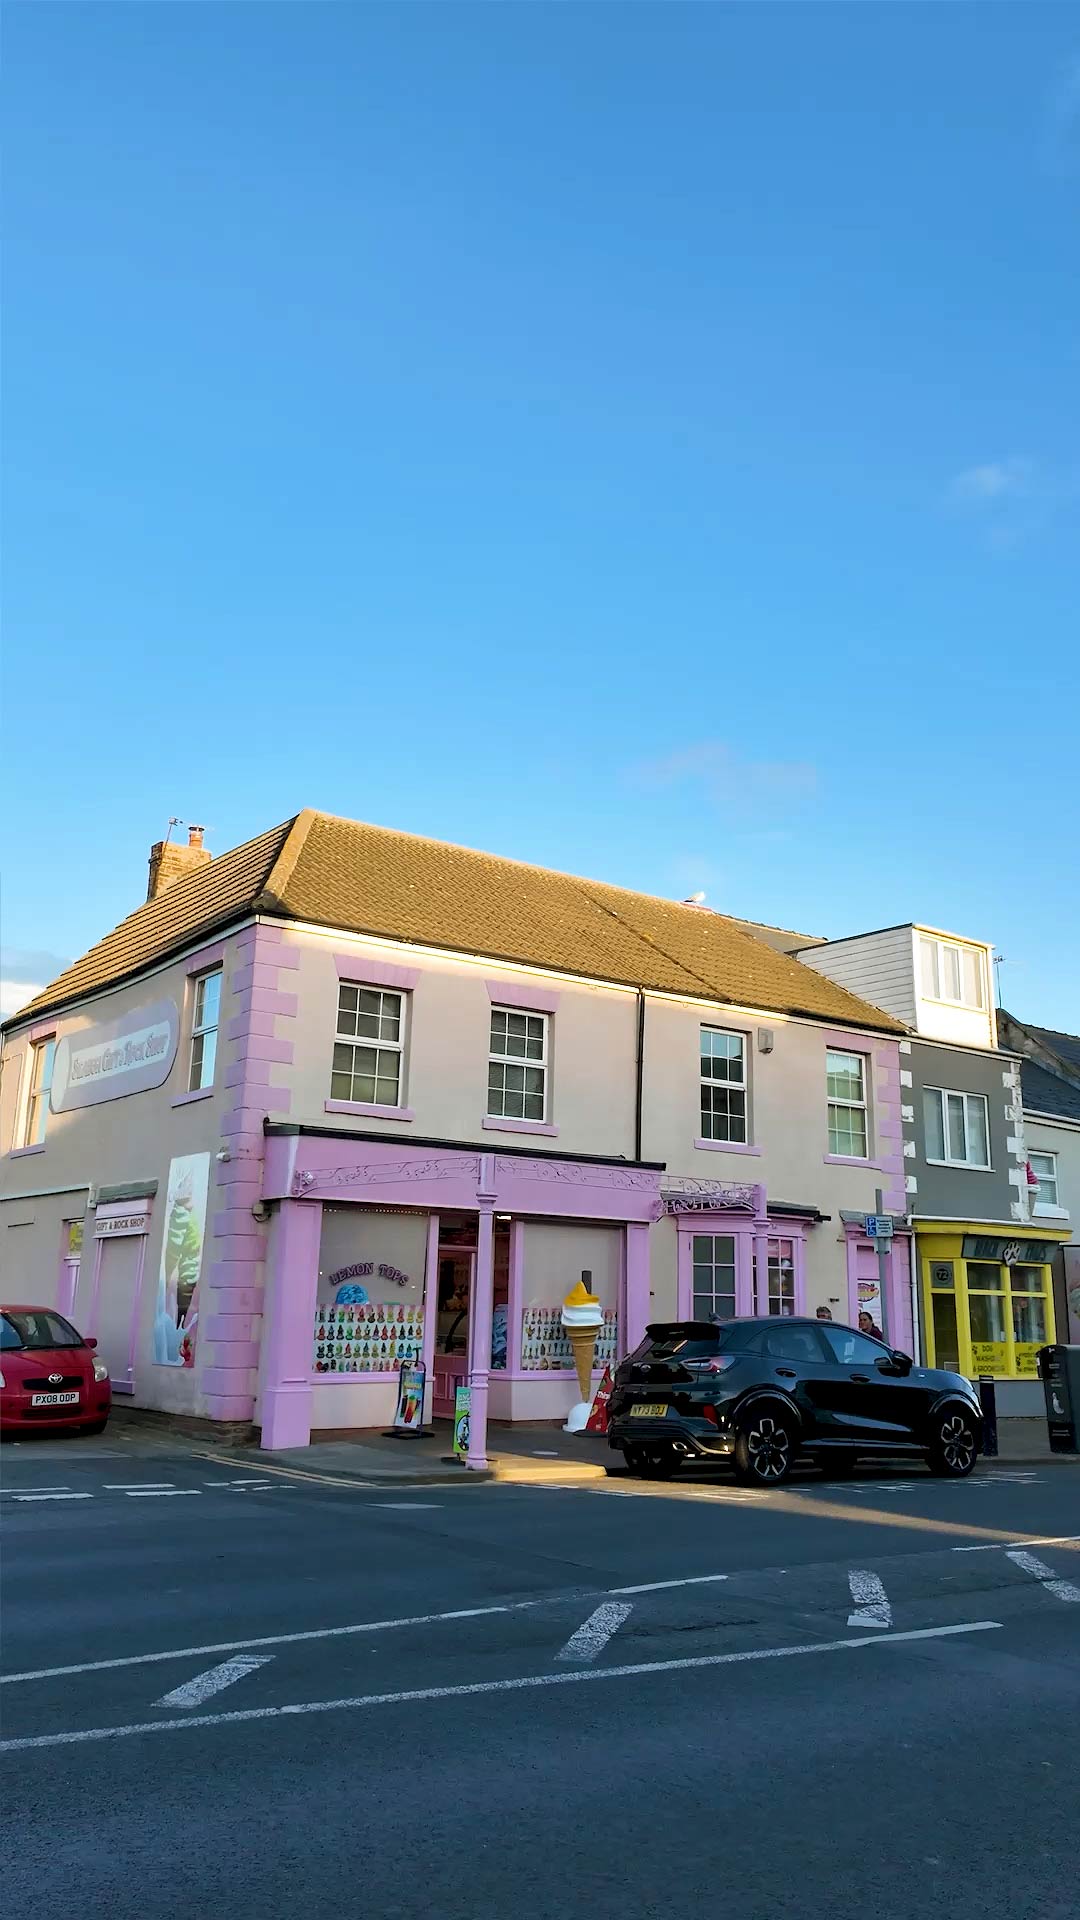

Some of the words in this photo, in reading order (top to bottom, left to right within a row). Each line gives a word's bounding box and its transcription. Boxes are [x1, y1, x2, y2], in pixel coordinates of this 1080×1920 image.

[97, 1221, 108, 1231] GIFT
[114, 1219, 129, 1230] ROCK
[129, 1217, 145, 1228] SHOP
[329, 1262, 374, 1286] LEMON
[379, 1263, 409, 1287] TOPS
[937, 1270, 948, 1280] 72
[36, 1394, 58, 1404] PX08
